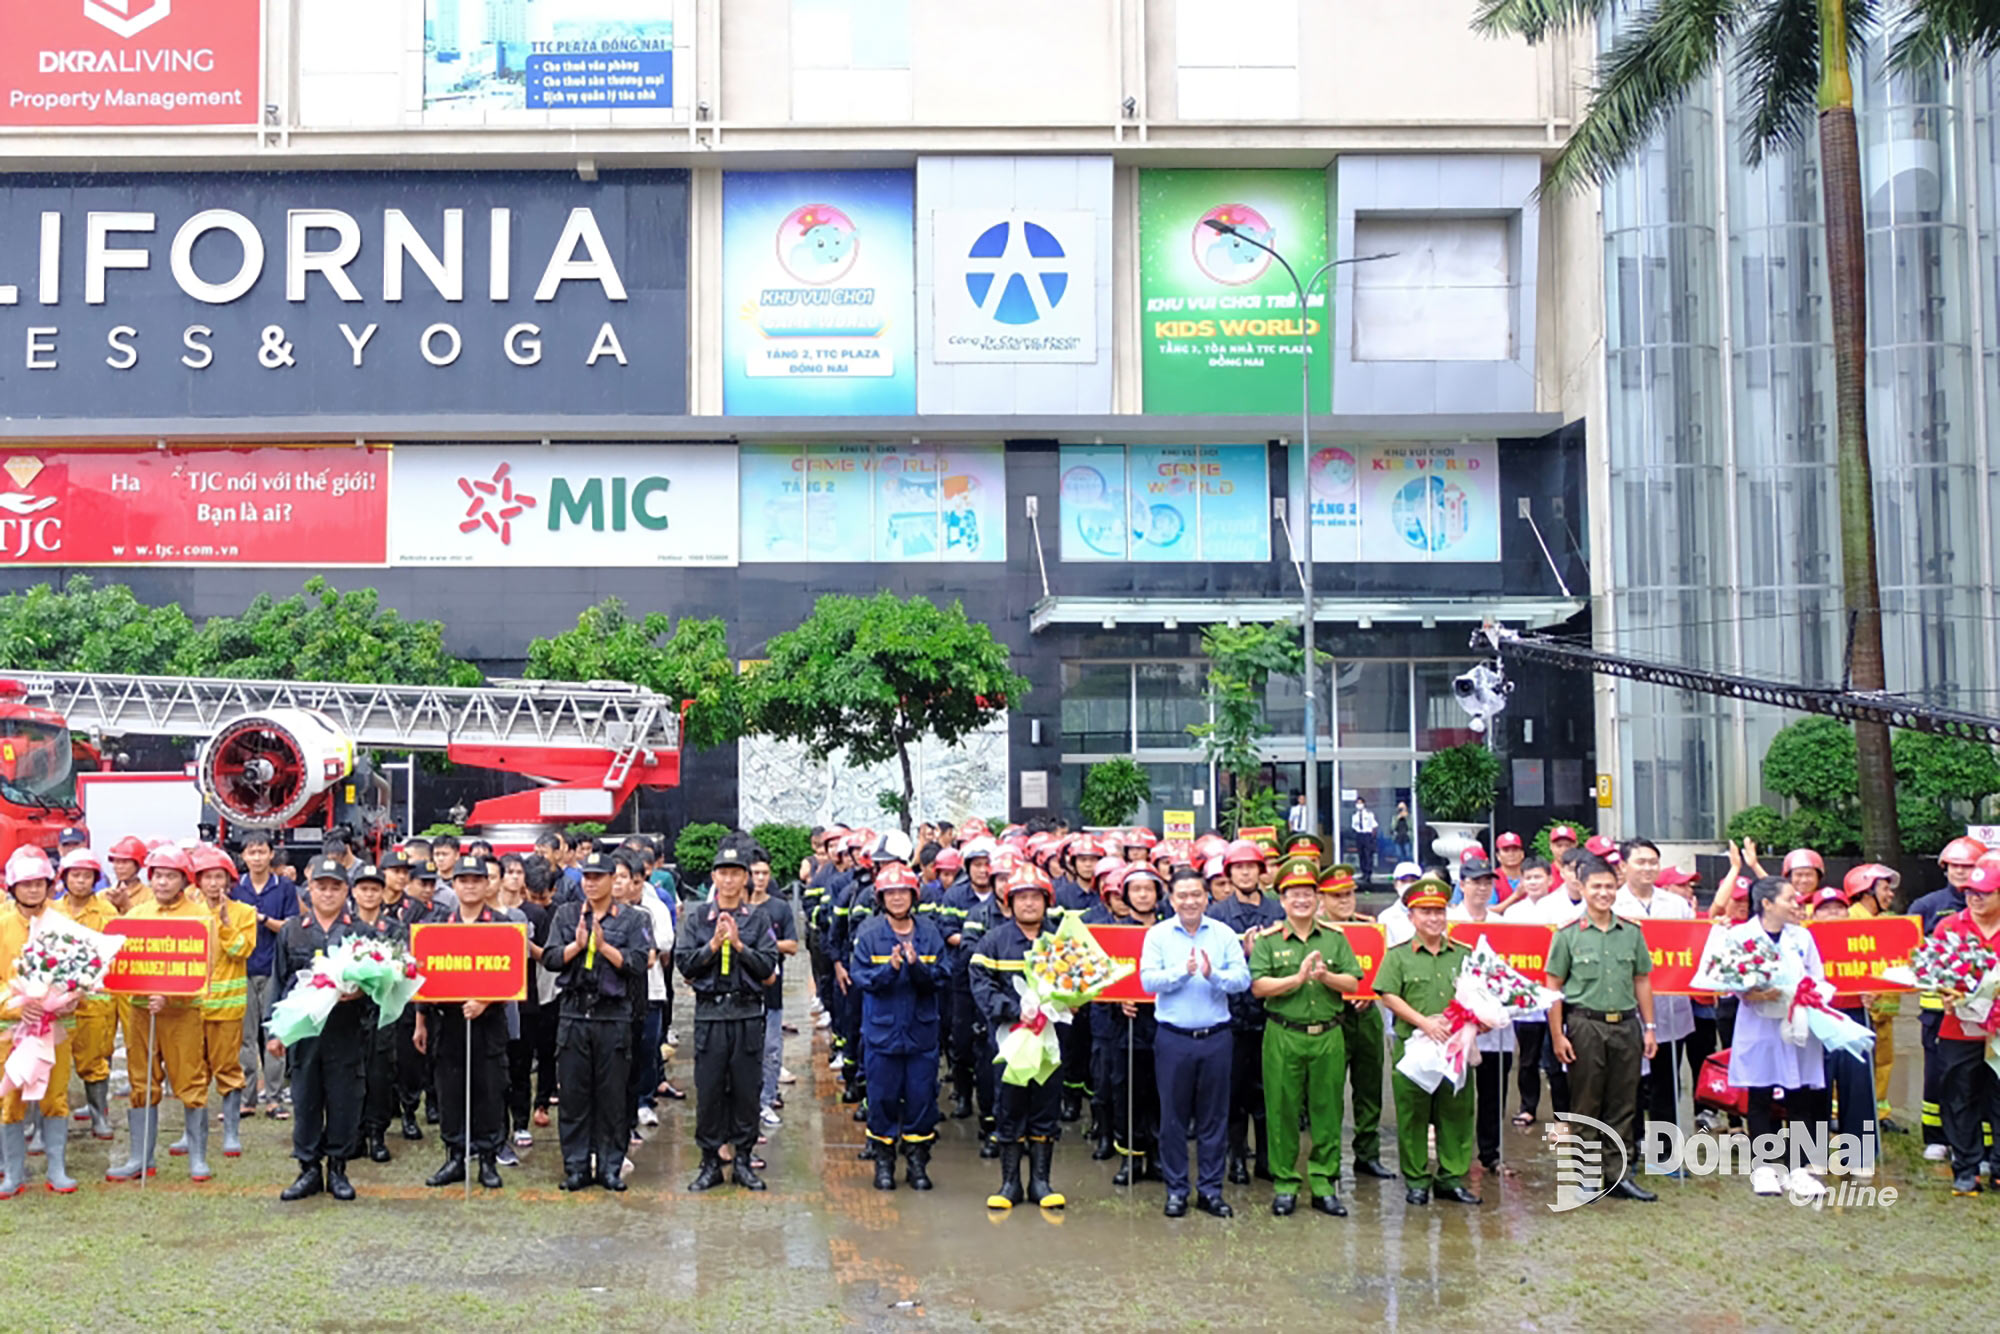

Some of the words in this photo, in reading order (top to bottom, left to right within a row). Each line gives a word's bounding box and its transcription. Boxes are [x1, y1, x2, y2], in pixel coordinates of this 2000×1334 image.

[531, 41, 553, 53] TTC
[556, 40, 598, 52] PLAZA
[641, 39, 666, 51] NAI
[39, 48, 216, 73] DKRALIVING
[543, 60, 561, 73] Cho
[543, 75, 561, 88] Cho
[10, 90, 100, 111] Property
[104, 89, 243, 110] Management
[760, 289, 799, 307] KHU
[801, 288, 830, 307] VUI
[1146, 297, 1184, 312] KHU
[1186, 296, 1217, 311] VUI
[1155, 320, 1217, 338] KIDS
[1219, 319, 1321, 337] WORLD
[816, 350, 839, 359] TTC
[841, 349, 881, 359] PLAZA
[1256, 345, 1277, 354] TTC
[827, 364, 849, 373] NAI
[1243, 358, 1265, 367] NAI
[791, 458, 856, 473] GAME
[1158, 463, 1222, 477] GAME
[187, 471, 223, 493] TJC
[227, 471, 258, 492] nói
[262, 470, 292, 492] với
[295, 467, 330, 492] thế
[331, 471, 377, 495] giới!
[548, 476, 671, 532] MIC
[197, 503, 236, 527] Bạn
[240, 501, 258, 522] là
[263, 502, 293, 522] ai?
[0, 517, 62, 557] TJC
[1847, 934, 1877, 955] HỘI
[427, 952, 473, 972] PHÒNG
[475, 954, 511, 972] PK02
[1665, 951, 1675, 968] Y
[1677, 947, 1693, 968] TẾ
